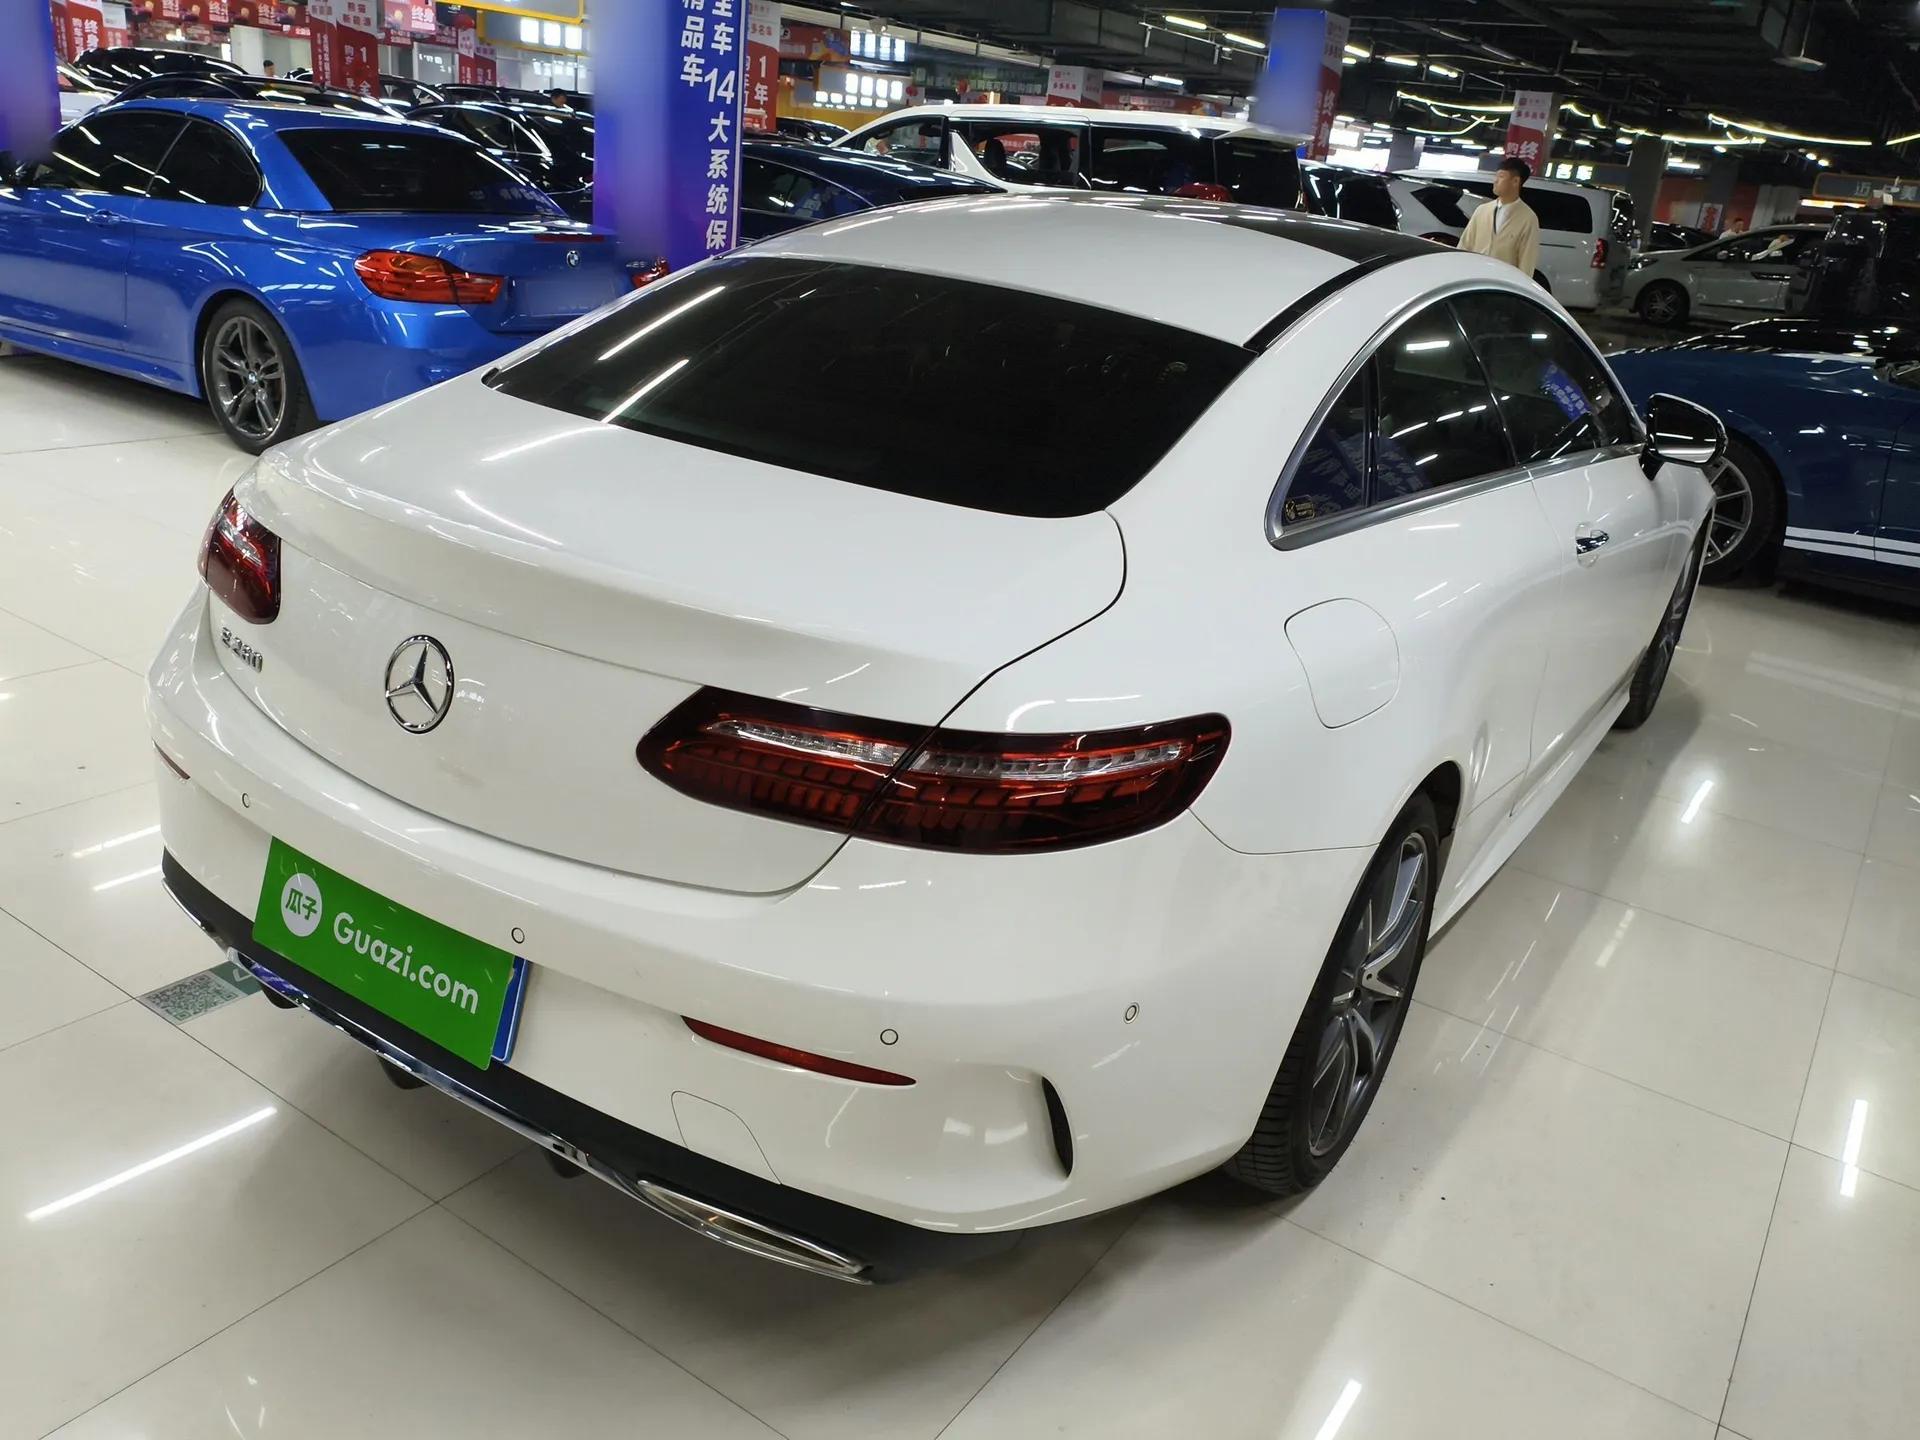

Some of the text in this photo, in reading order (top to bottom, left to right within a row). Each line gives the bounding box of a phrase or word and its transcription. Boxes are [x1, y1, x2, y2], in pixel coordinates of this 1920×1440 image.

[703, 0, 737, 258] 全车14大系统保
[285, 888, 318, 921] 瓜子
[333, 911, 479, 1015] Guazi.com
